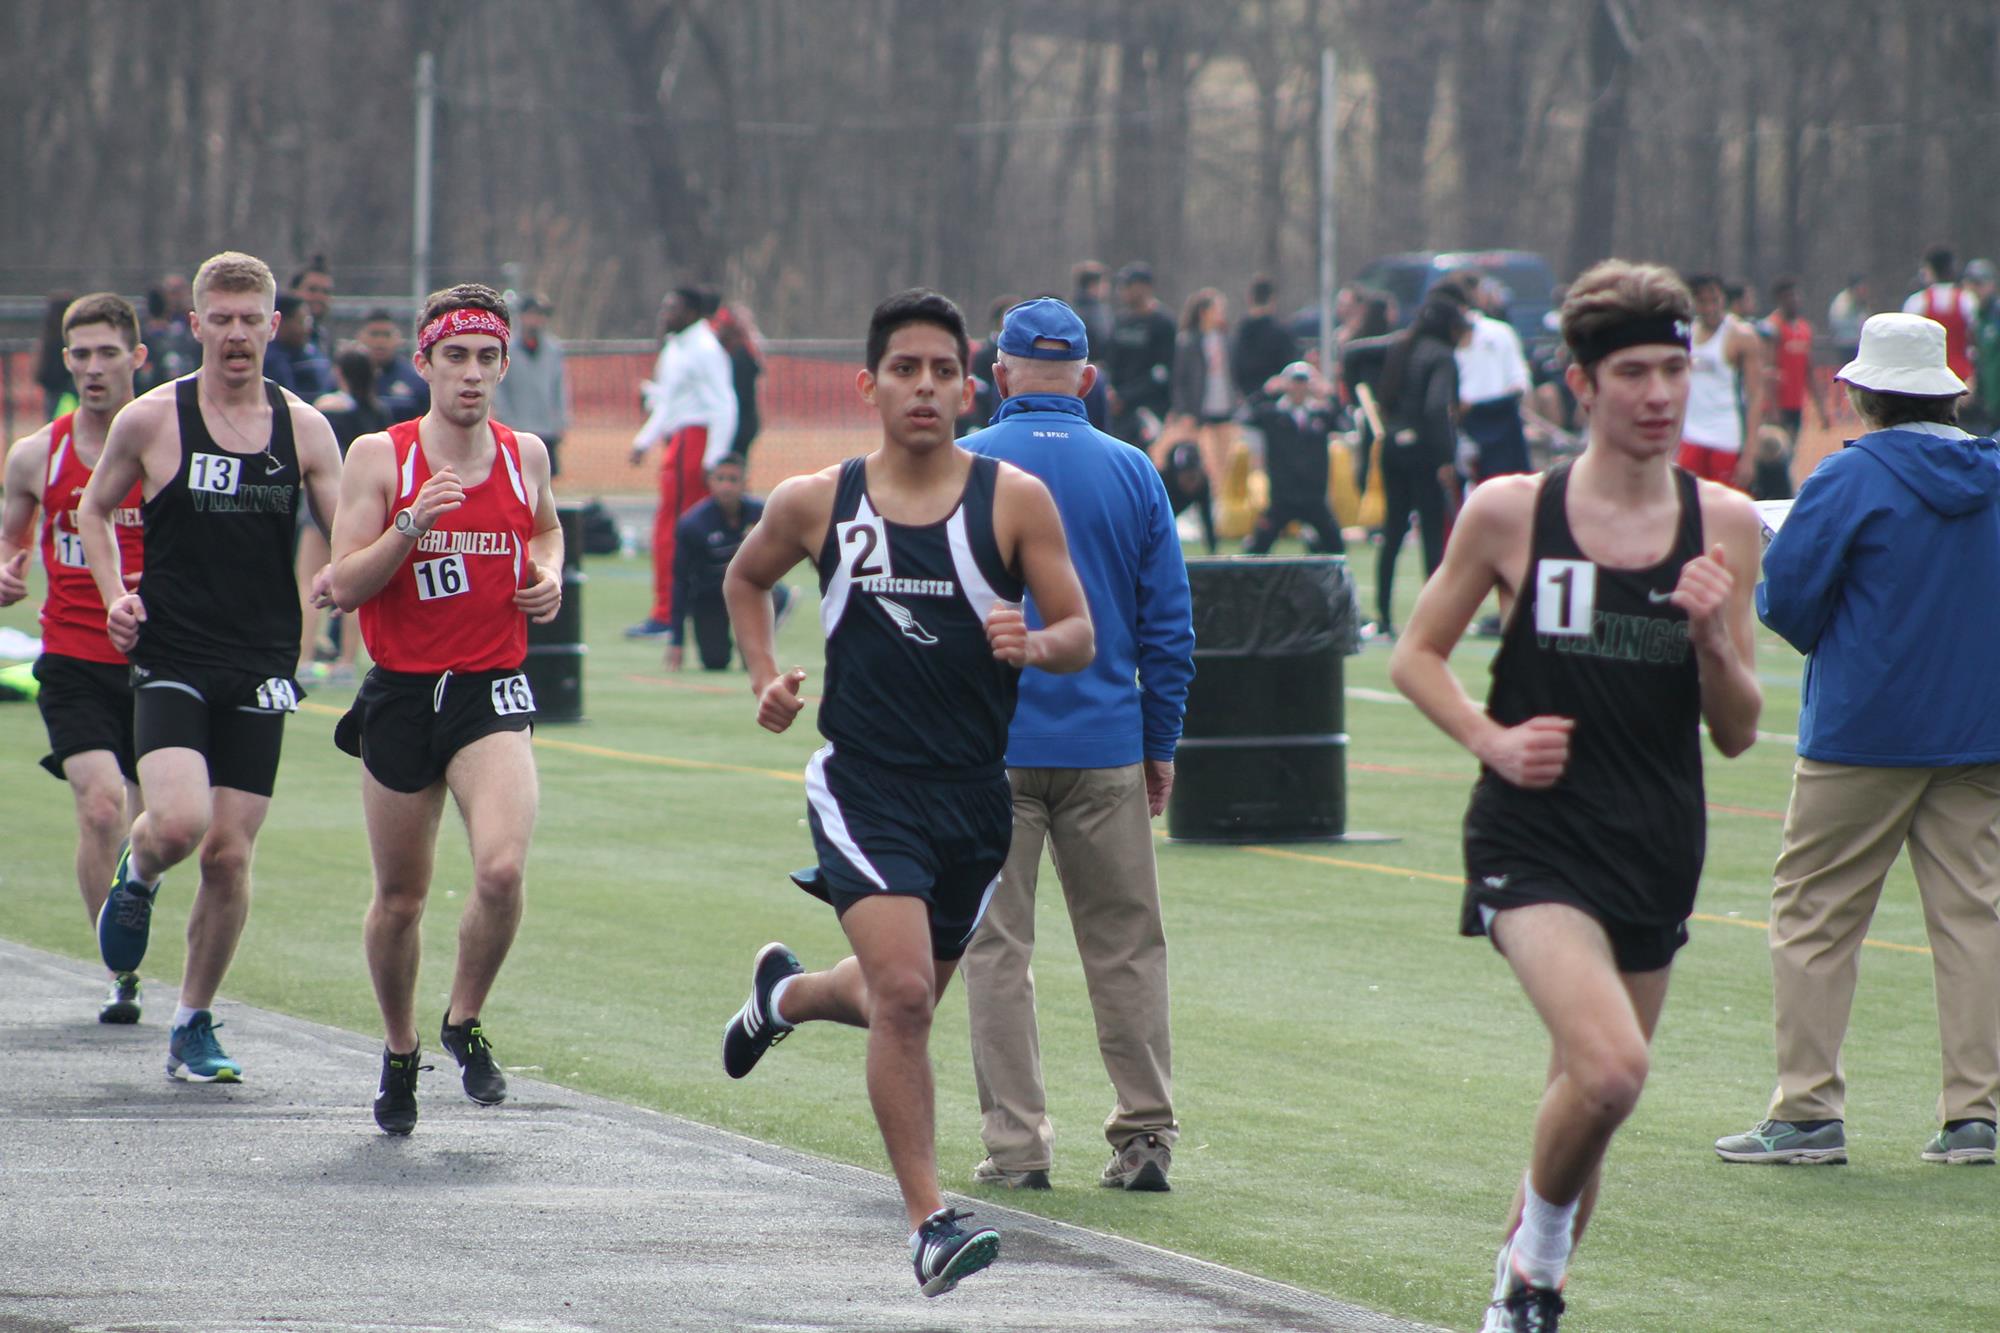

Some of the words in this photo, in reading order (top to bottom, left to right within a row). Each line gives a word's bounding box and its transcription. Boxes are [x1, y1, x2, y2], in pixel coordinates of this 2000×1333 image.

[196, 456, 232, 491] 13
[417, 529, 511, 555] CALDWELL
[844, 523, 884, 578] 2
[418, 558, 462, 597] 16
[861, 577, 954, 596] WESTCHESTER
[1547, 566, 1574, 628] 1
[259, 678, 291, 710] 13
[495, 677, 529, 712] 16
